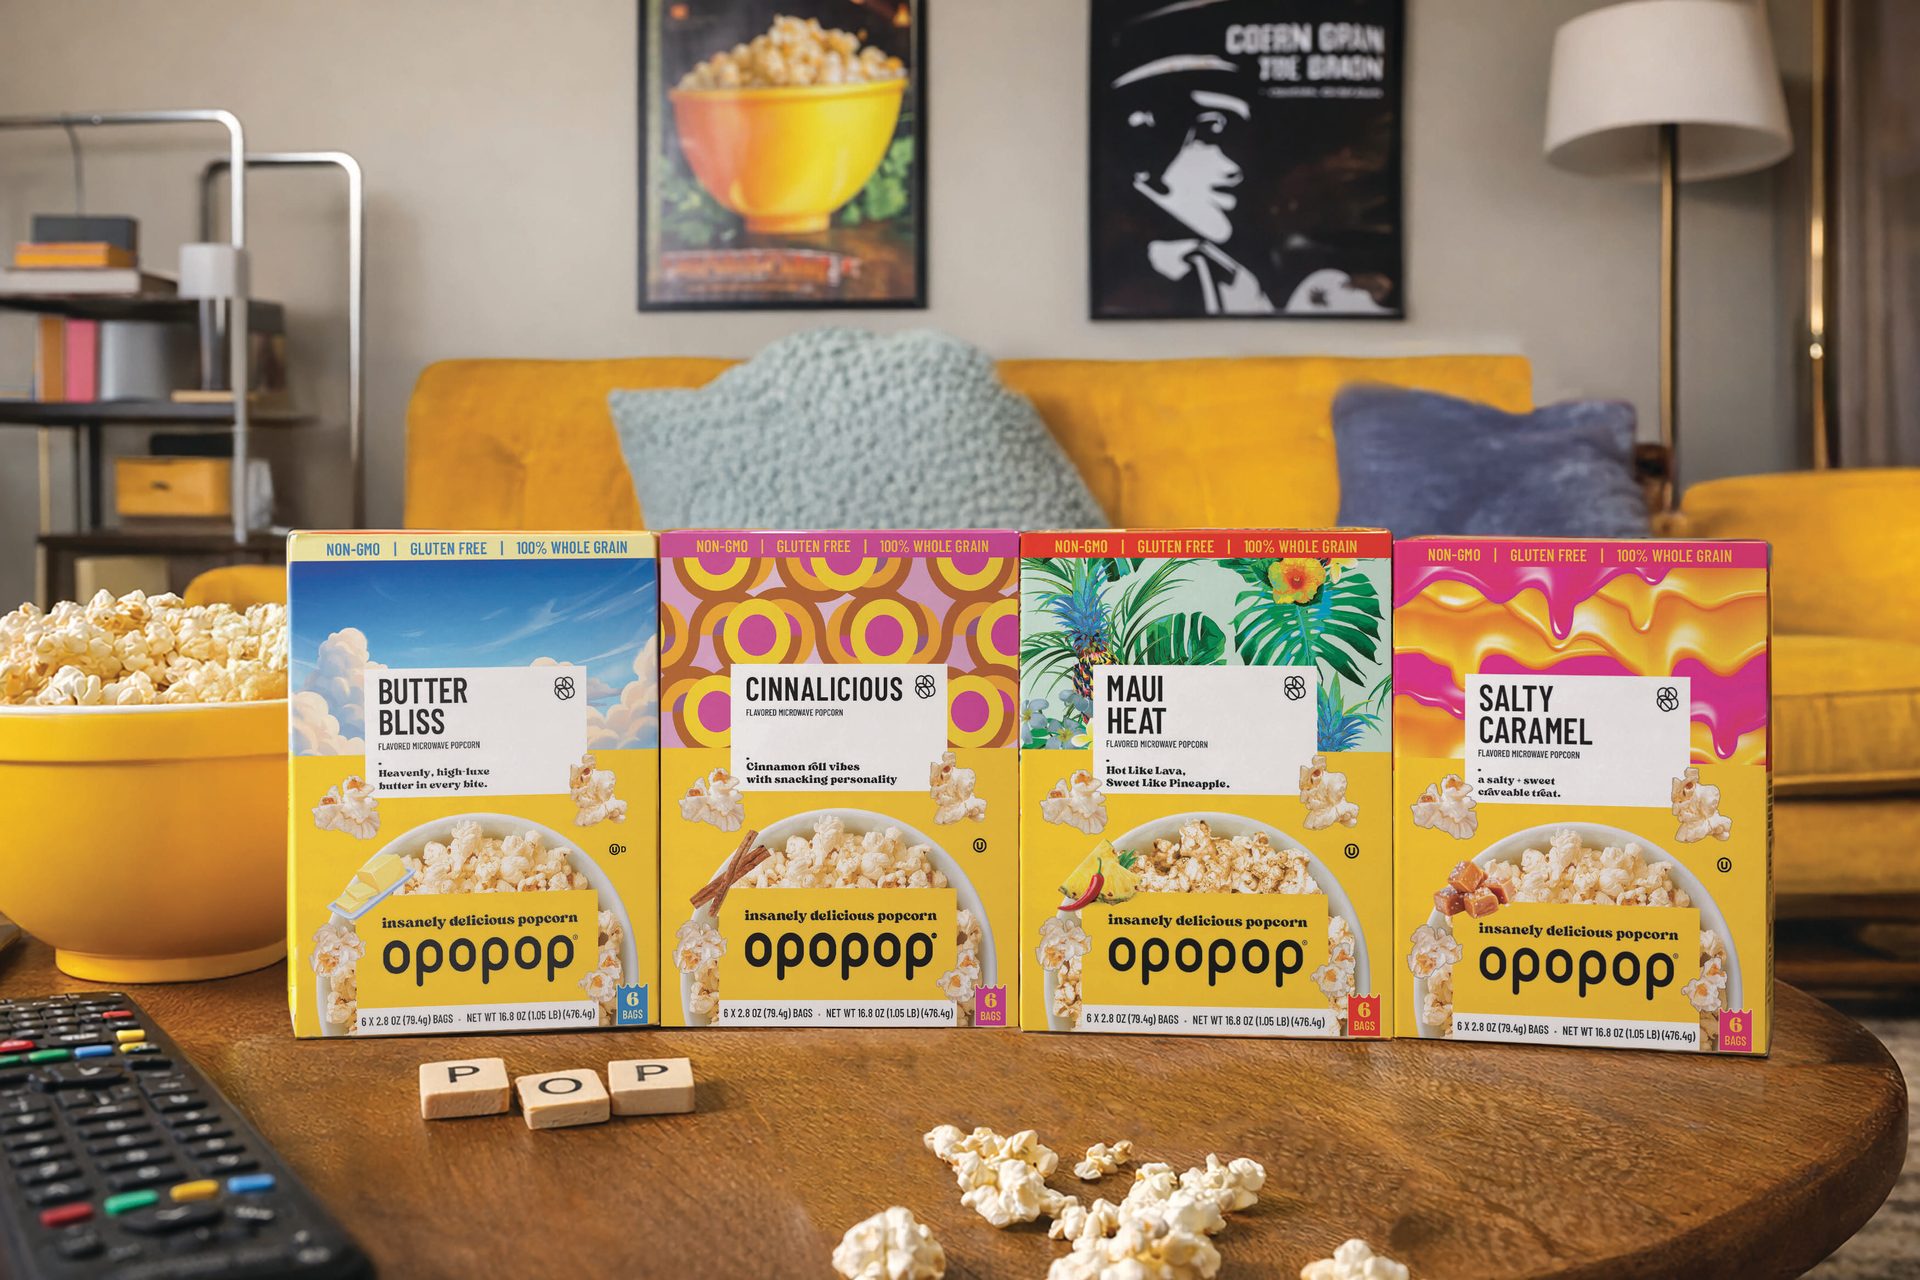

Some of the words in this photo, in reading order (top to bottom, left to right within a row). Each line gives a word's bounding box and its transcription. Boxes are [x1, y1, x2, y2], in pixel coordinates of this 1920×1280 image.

[327, 543, 379, 556] NON-GMO
[411, 542, 454, 555] GLUTEN
[459, 542, 487, 555] FREE
[517, 542, 547, 554] 100%
[551, 541, 590, 554] WHOLE
[594, 541, 627, 554] GRAIN
[696, 540, 748, 552] NON-GMO
[776, 540, 820, 553] GLUTEN
[823, 539, 851, 552] FREE
[880, 540, 909, 552] 100%
[913, 540, 952, 553] WHOLE
[955, 540, 989, 552] GRAIN
[1055, 540, 1107, 553] NON-GMO
[1138, 540, 1181, 553] GLUTEN
[1186, 540, 1214, 553] FREE
[1244, 540, 1274, 553] 100%
[1279, 540, 1319, 553] WHOLE
[1323, 540, 1357, 553] GRAIN
[1428, 549, 1480, 561] NON-GMO
[1510, 548, 1554, 562] GLUTEN
[1559, 549, 1587, 562] FREE
[1617, 549, 1648, 562] 100%
[1652, 549, 1692, 562] WHOLE
[1696, 550, 1732, 562] GRAIN
[379, 678, 467, 704] BUTTER
[747, 677, 902, 701] CINNALICIOUS
[1108, 675, 1162, 702] MAUI
[1480, 684, 1553, 712] SALTY
[380, 709, 444, 735] BLISS
[1108, 707, 1166, 734] HEAT
[1480, 716, 1592, 745] CARAMEL
[451, 741, 480, 749] POPCORN
[1106, 740, 1138, 748] FLAVORED
[1141, 740, 1176, 748] MICROWAVE
[1478, 749, 1510, 757] FLAVORED
[1512, 750, 1548, 758] MICROWAVE
[1550, 751, 1580, 759] POPCORN
[747, 762, 805, 770] Cinnamon
[829, 762, 860, 770] vibes
[1107, 766, 1126, 774] Hot
[1128, 766, 1153, 774] Like
[1156, 767, 1185, 776] Lava,
[379, 769, 434, 779] Heavenly,
[437, 768, 489, 778] high-luxe
[747, 775, 772, 783] with
[775, 775, 828, 785] snacking
[831, 775, 897, 785] personality
[416, 781, 427, 789] in
[430, 782, 460, 790] every
[464, 780, 487, 788] bite.
[1106, 779, 1139, 787] Sweet
[1143, 779, 1166, 787] Like
[1170, 779, 1229, 790] Pineapple.
[1487, 776, 1514, 786] salty
[1478, 788, 1530, 796] craveable
[1532, 789, 1560, 797] treat.
[382, 916, 446, 929] insanely
[449, 914, 515, 926] delicious
[518, 914, 577, 927] popcorn
[745, 910, 807, 923] insanely
[810, 910, 874, 920] delicious
[878, 912, 937, 923] popcorn
[1109, 914, 1172, 928] insanely
[1176, 915, 1242, 926] delicious
[1246, 918, 1307, 929] popcorn
[1479, 923, 1543, 938] insanely
[1546, 925, 1613, 938] delicious
[1616, 930, 1678, 941] popcorn
[627, 992, 639, 1006] 6
[985, 993, 997, 1008] 6
[467, 1013, 481, 1022] NET
[485, 1013, 496, 1021] WT
[499, 1012, 514, 1021] 16.8
[517, 1011, 526, 1020] OZ
[528, 1011, 546, 1021] (1.05
[549, 1010, 561, 1020] LB)
[563, 1008, 595, 1020] (476.4g)
[623, 1009, 643, 1019] BAGS
[724, 1009, 728, 1017] 6
[731, 1009, 735, 1017] X
[738, 1009, 750, 1017] 2.8
[752, 1009, 761, 1017] OZ
[764, 1008, 791, 1020] (79.4g)
[793, 1009, 812, 1017] BAGS
[827, 1009, 841, 1017] NET
[844, 1009, 856, 1017] WT
[858, 1009, 872, 1017] 16.8
[875, 1009, 884, 1017] OZ
[887, 1008, 904, 1018] (1.05
[907, 1008, 919, 1018] LB)
[921, 1008, 953, 1020] (476.4g)
[981, 1011, 1001, 1021] BAGS
[1358, 1002, 1371, 1017] 6
[362, 1017, 366, 1026] 6
[369, 1017, 373, 1026] X
[376, 1016, 388, 1026] 2.8
[391, 1016, 400, 1025] OZ
[403, 1015, 431, 1026] (79.4g)
[433, 1014, 453, 1024] BAGS
[1087, 1013, 1091, 1022] 6
[1094, 1014, 1099, 1022] X
[1101, 1014, 1113, 1023] 2.8
[1116, 1014, 1126, 1023] OZ
[1128, 1014, 1156, 1026] (79.4g)
[1158, 1015, 1178, 1024] BAGS
[1193, 1016, 1208, 1024] NET
[1211, 1016, 1223, 1025] WT
[1226, 1016, 1240, 1025] 16.8
[1243, 1016, 1253, 1025] OZ
[1256, 1016, 1274, 1026] (1.05
[1277, 1016, 1289, 1027] LB)
[1291, 1017, 1325, 1029] (476.4g)
[1354, 1021, 1375, 1031] BAGS
[1730, 1017, 1742, 1032] 6
[1458, 1022, 1462, 1030] 6
[1465, 1022, 1469, 1031] X
[1472, 1022, 1484, 1031] 2.8
[1487, 1023, 1496, 1032] OZ
[1498, 1023, 1526, 1035] (79.4g)
[1529, 1025, 1549, 1034] BAGS
[1563, 1026, 1578, 1035] NET
[1581, 1027, 1593, 1036] WT
[1596, 1028, 1611, 1037] 16.8
[1614, 1028, 1623, 1038] OZ
[1626, 1028, 1644, 1039] (1.05
[1647, 1030, 1660, 1040] LB)
[1662, 1030, 1695, 1043] (476.4g)
[1725, 1035, 1747, 1046] BAGS
